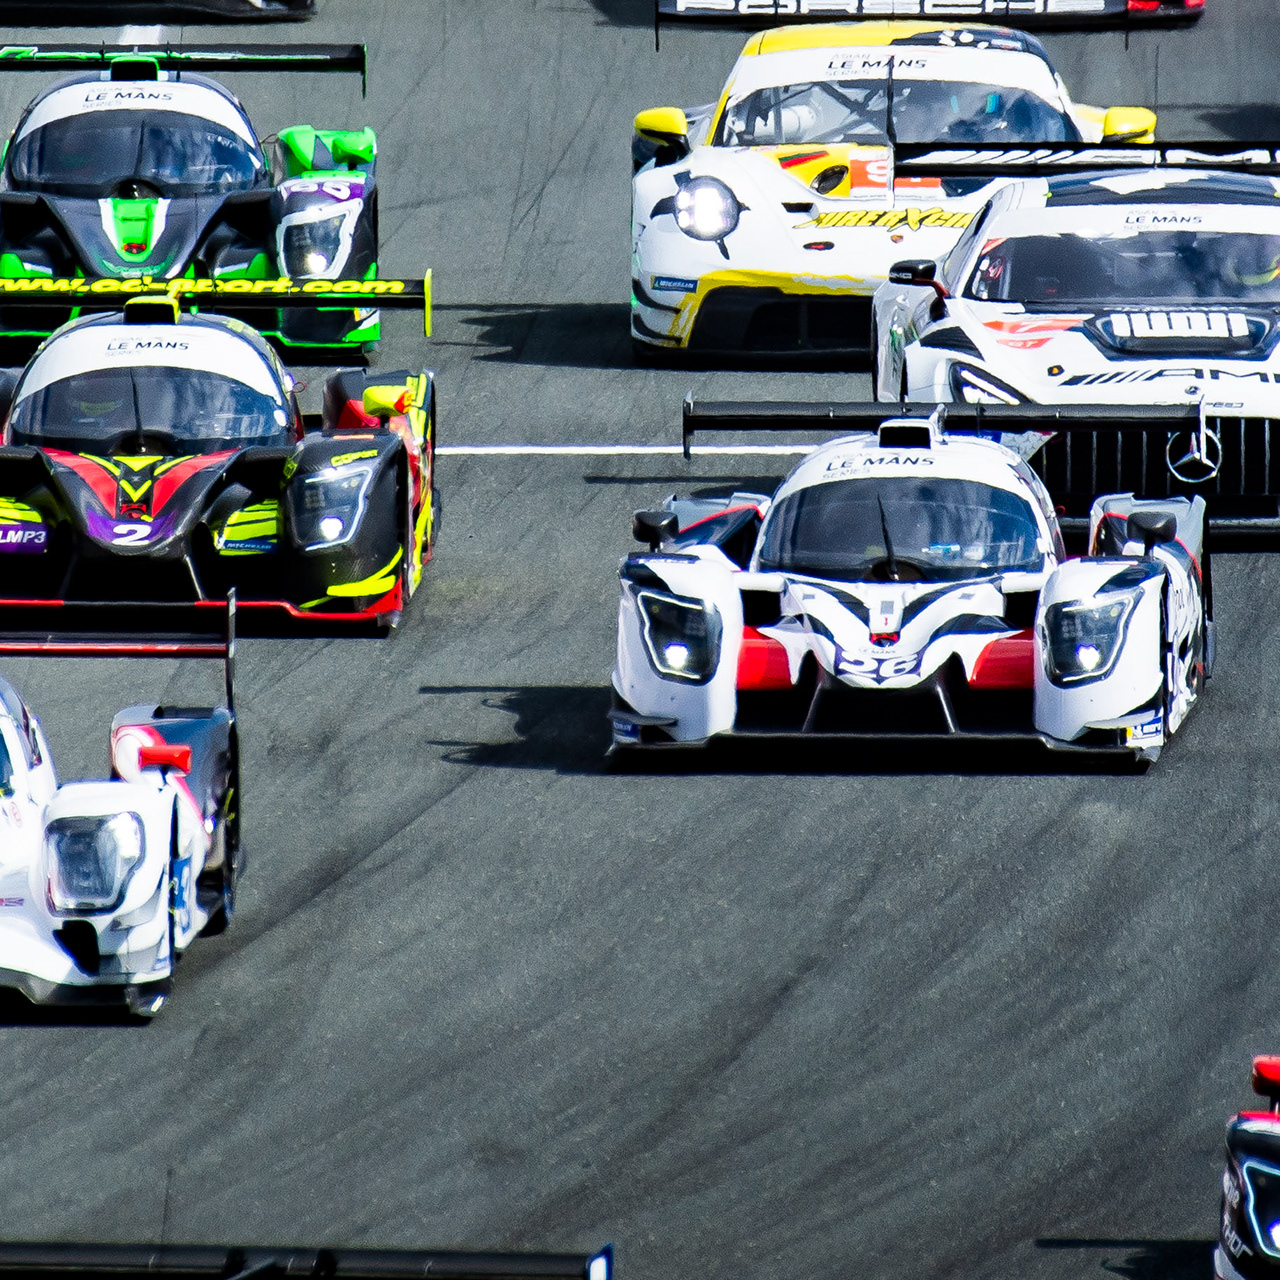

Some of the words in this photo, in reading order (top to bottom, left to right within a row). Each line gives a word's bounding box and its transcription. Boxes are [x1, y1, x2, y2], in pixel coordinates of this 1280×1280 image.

[827, 60, 856, 69] LE
[861, 59, 928, 69] MANS
[84, 93, 108, 102] LE
[114, 92, 173, 101] MANS
[1125, 215, 1145, 224] LE
[1151, 215, 1203, 224] MANS
[106, 342, 129, 351] LE
[135, 341, 190, 351] MANS
[825, 460, 854, 471] LE
[863, 457, 936, 466] MANS
[110, 523, 153, 546] 2
[838, 651, 918, 678] 26
